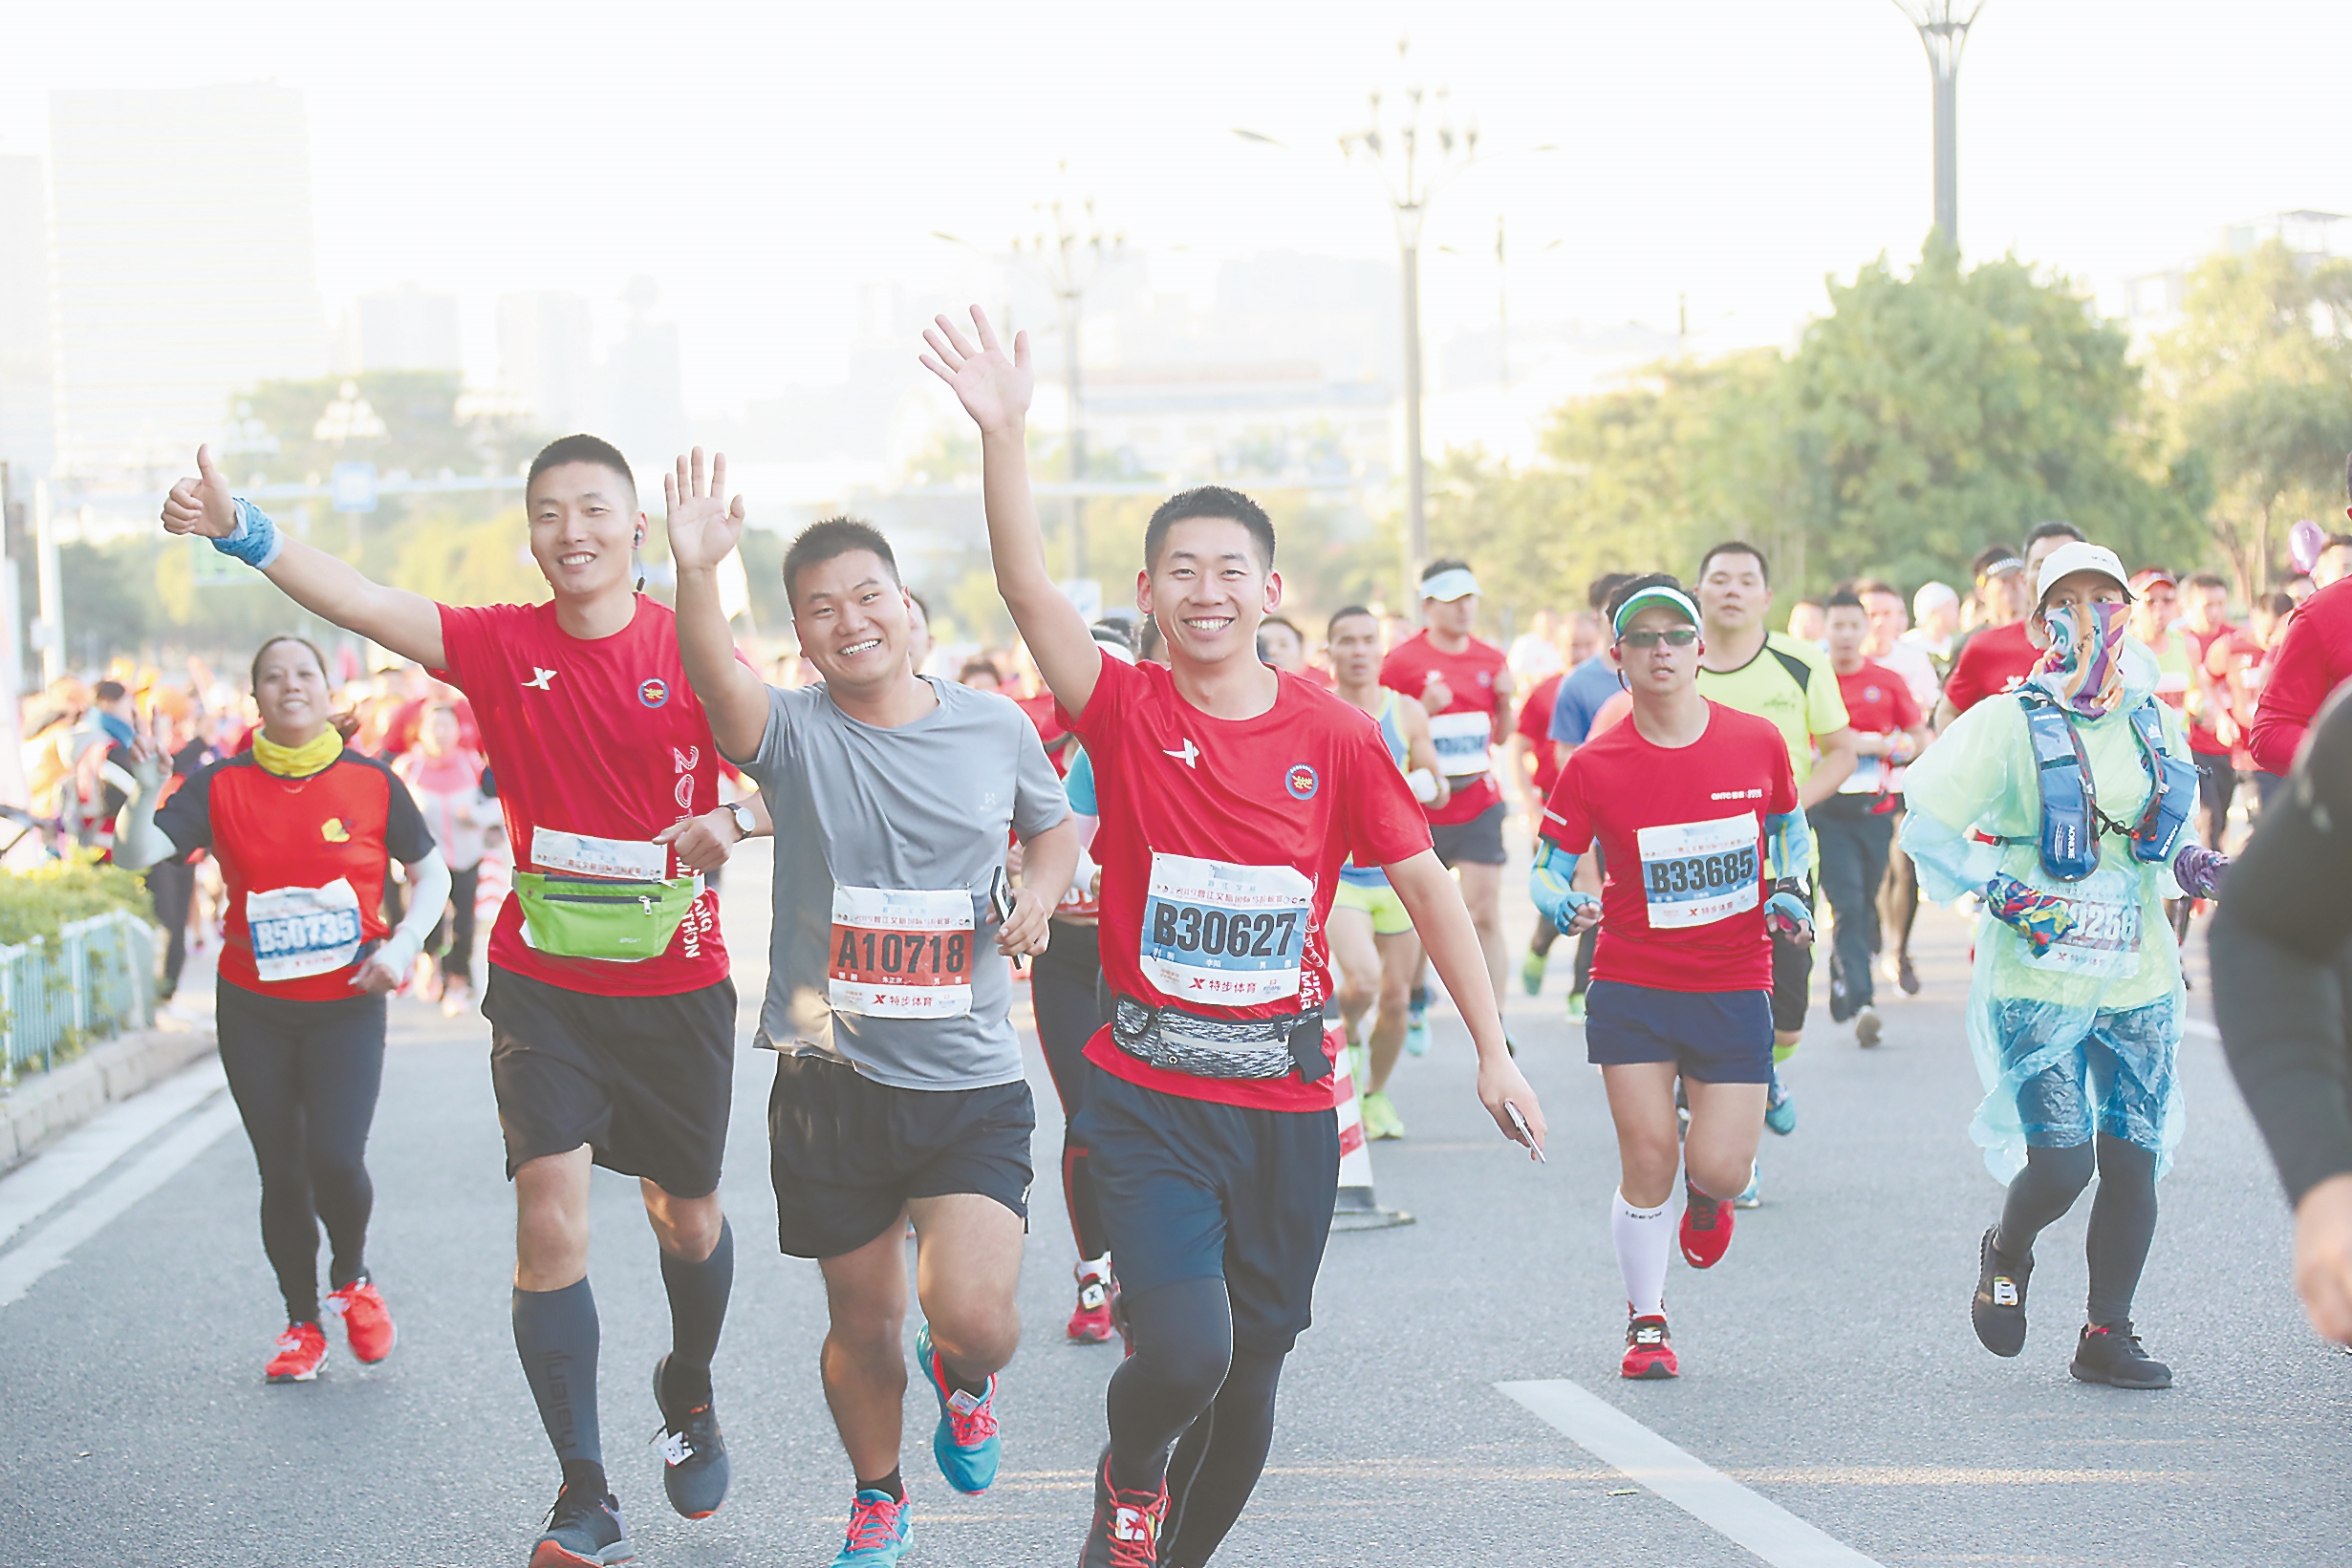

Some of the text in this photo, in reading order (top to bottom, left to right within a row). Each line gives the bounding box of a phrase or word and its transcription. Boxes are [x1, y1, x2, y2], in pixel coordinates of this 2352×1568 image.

[1650, 848, 1753, 894] B33685
[254, 911, 357, 953] B50735
[1153, 901, 1297, 957] B30627
[836, 930, 964, 974] A10718
[890, 995, 933, 1007] 特步体育
[1209, 979, 1257, 994] 特步体育
